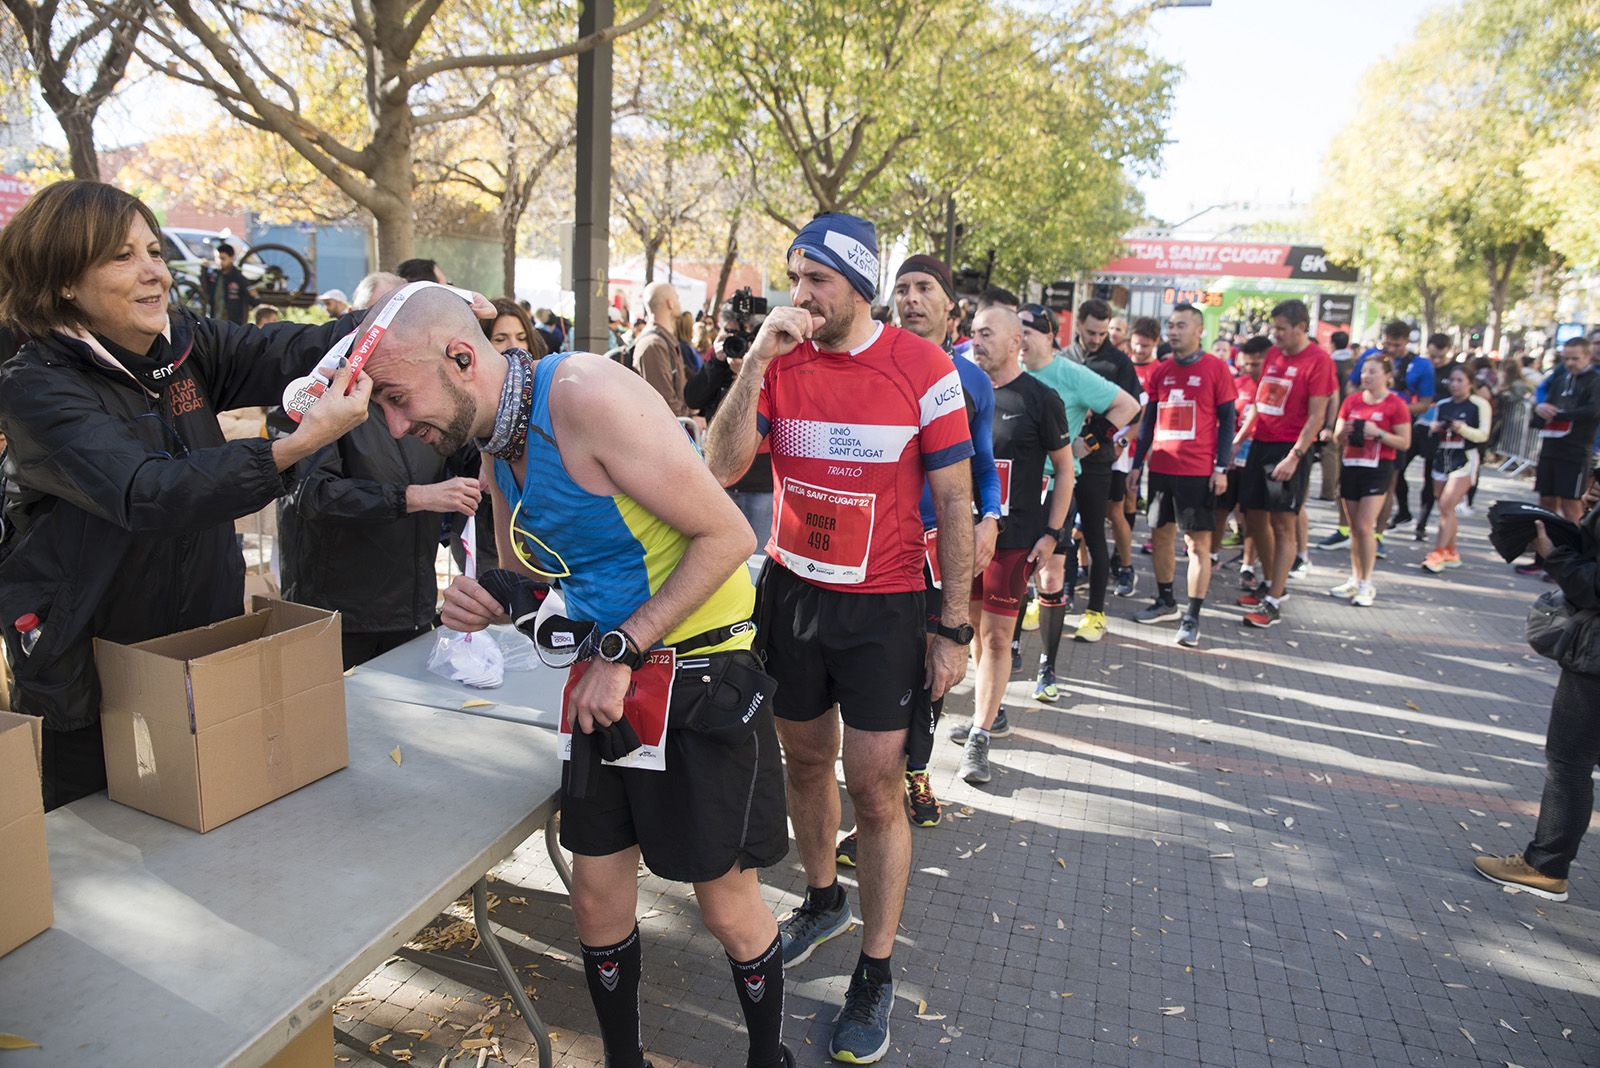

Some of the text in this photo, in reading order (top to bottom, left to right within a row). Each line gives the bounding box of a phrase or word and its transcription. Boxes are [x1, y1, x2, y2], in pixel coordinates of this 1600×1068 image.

[1168, 245, 1217, 261] SANT
[1218, 246, 1282, 265] CUGAT
[1300, 254, 1328, 273] 5K
[359, 327, 381, 355] MITJA
[297, 390, 317, 404] MITJ
[934, 383, 962, 407] UCSC
[829, 426, 851, 436] UNIÓ
[829, 437, 862, 447] CICLISTA
[829, 446, 884, 458] SANT CUGAT
[826, 465, 863, 478] TRIATLÓ
[787, 484, 870, 507] MITJA SANT CUGAT 22
[805, 512, 837, 531] ROGER
[807, 531, 831, 552] 498
[658, 654, 670, 664] 22
